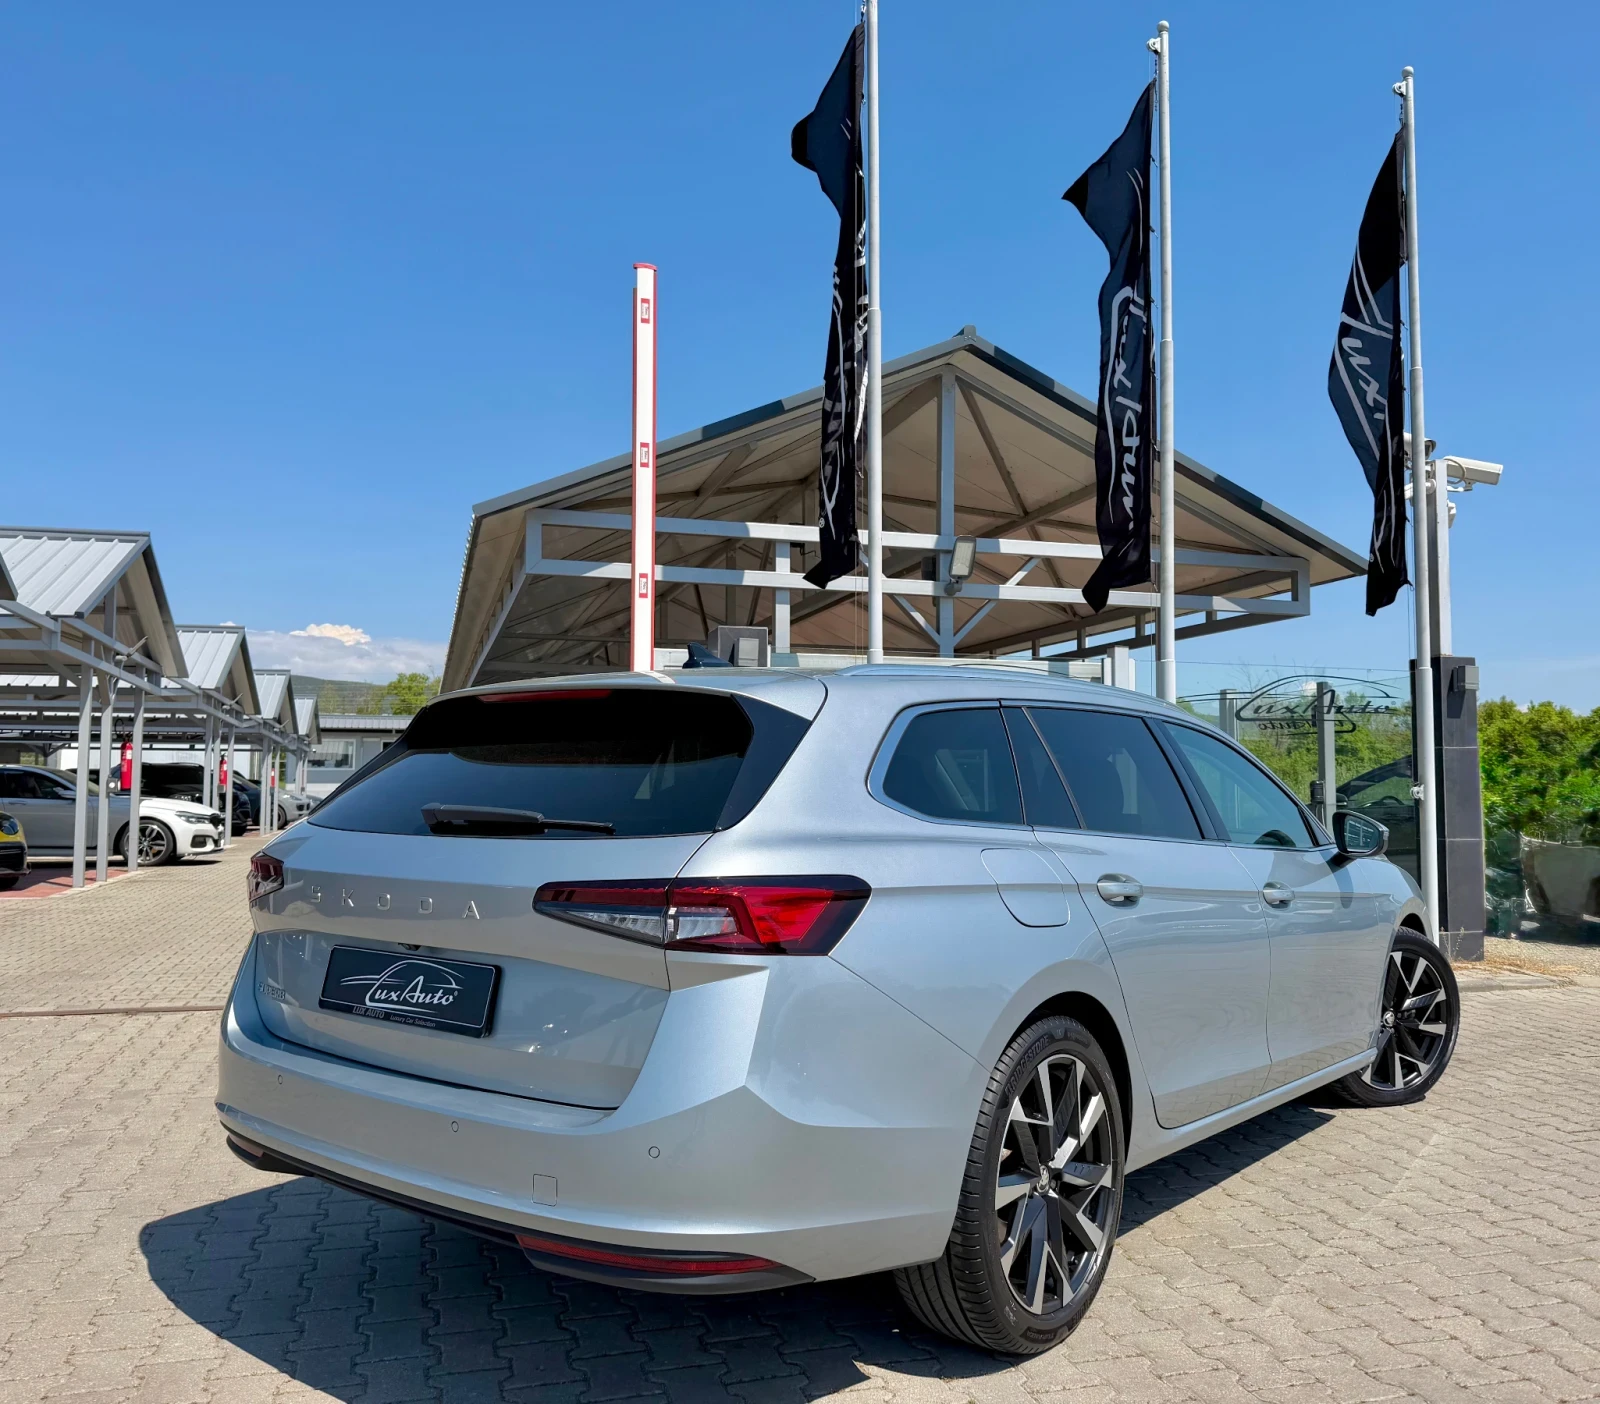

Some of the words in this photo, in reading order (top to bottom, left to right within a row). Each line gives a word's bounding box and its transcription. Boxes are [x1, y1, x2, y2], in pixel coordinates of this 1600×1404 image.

[352, 1006, 366, 1015] LUX
[366, 1008, 385, 1019] AUTO
[414, 1018, 436, 1028] Selection
